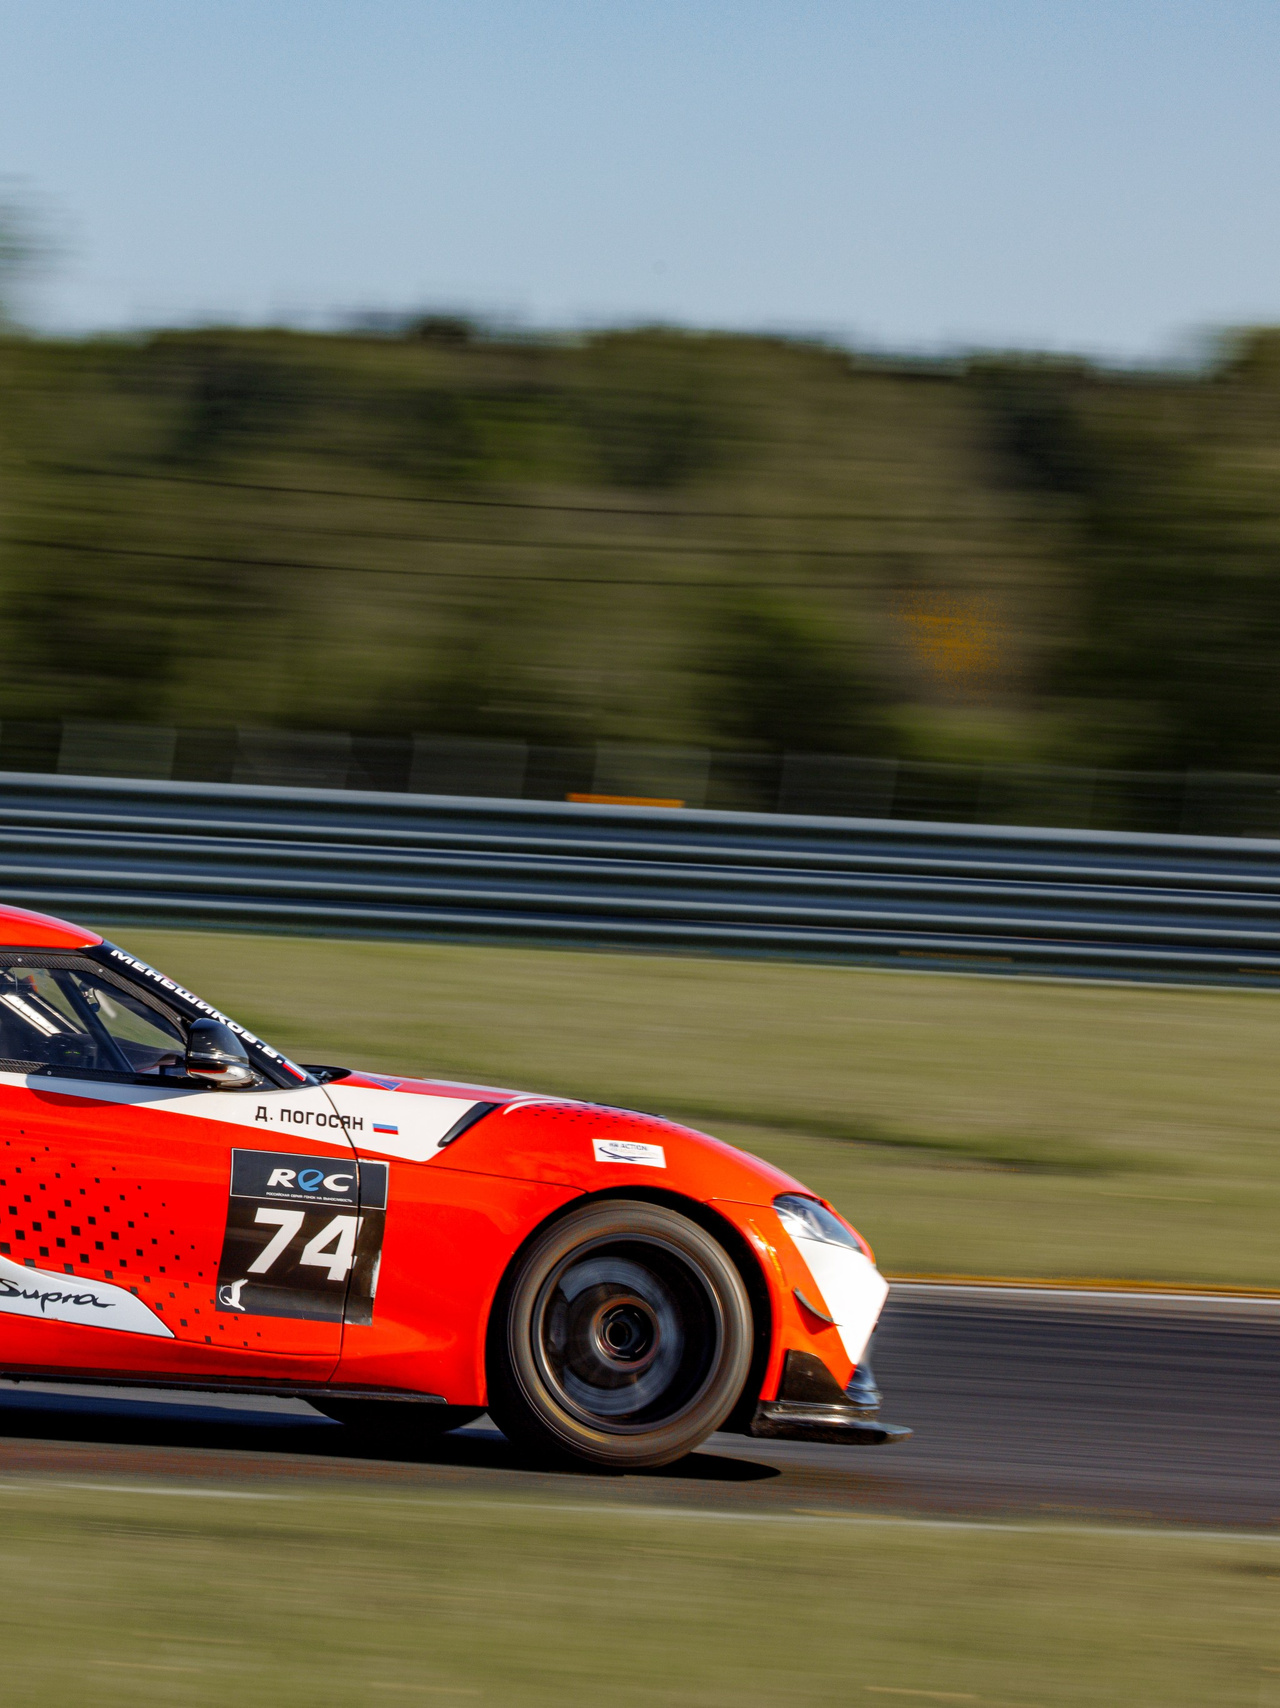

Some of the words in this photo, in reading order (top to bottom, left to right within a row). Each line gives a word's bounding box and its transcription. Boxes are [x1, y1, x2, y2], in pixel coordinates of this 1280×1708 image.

[255, 1106, 273, 1122] Д.
[280, 1108, 364, 1131] ПОГОСЯН
[247, 1207, 364, 1281] 74
